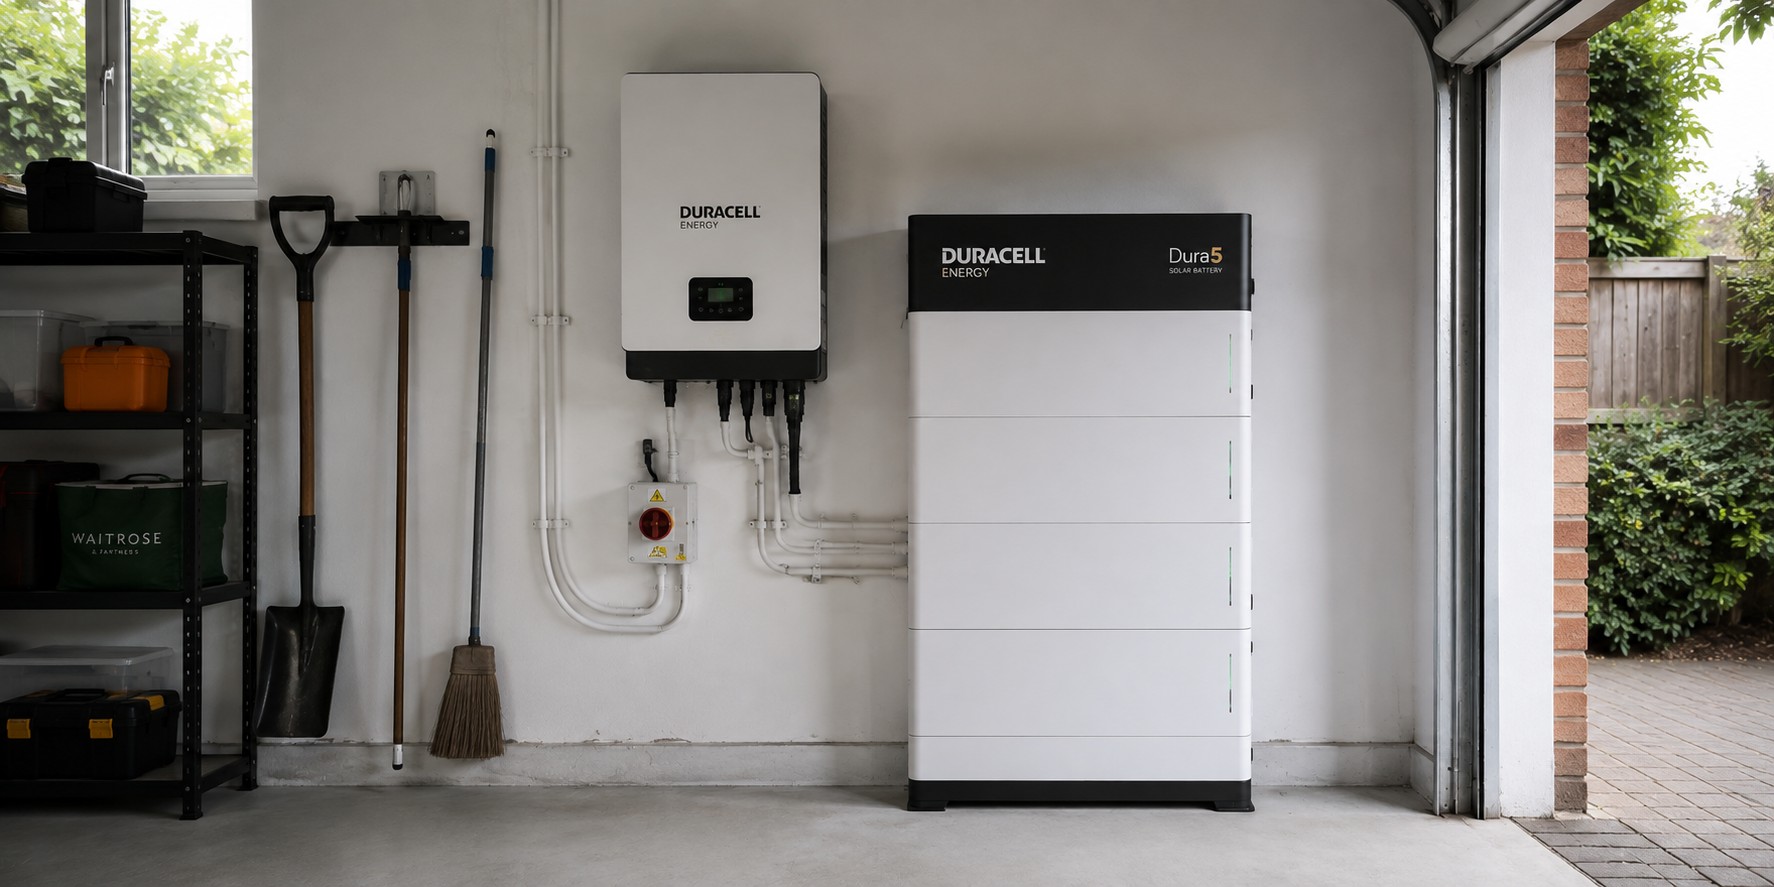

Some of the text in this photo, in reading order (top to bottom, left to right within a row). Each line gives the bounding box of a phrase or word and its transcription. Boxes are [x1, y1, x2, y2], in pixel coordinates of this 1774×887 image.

[680, 205, 761, 219] DURACELL
[680, 221, 719, 230] ENERGY
[941, 247, 1046, 265] DURACELL
[1169, 246, 1223, 265] Dura5
[941, 267, 990, 278] ENERGY
[71, 532, 162, 545] WAITROSE
